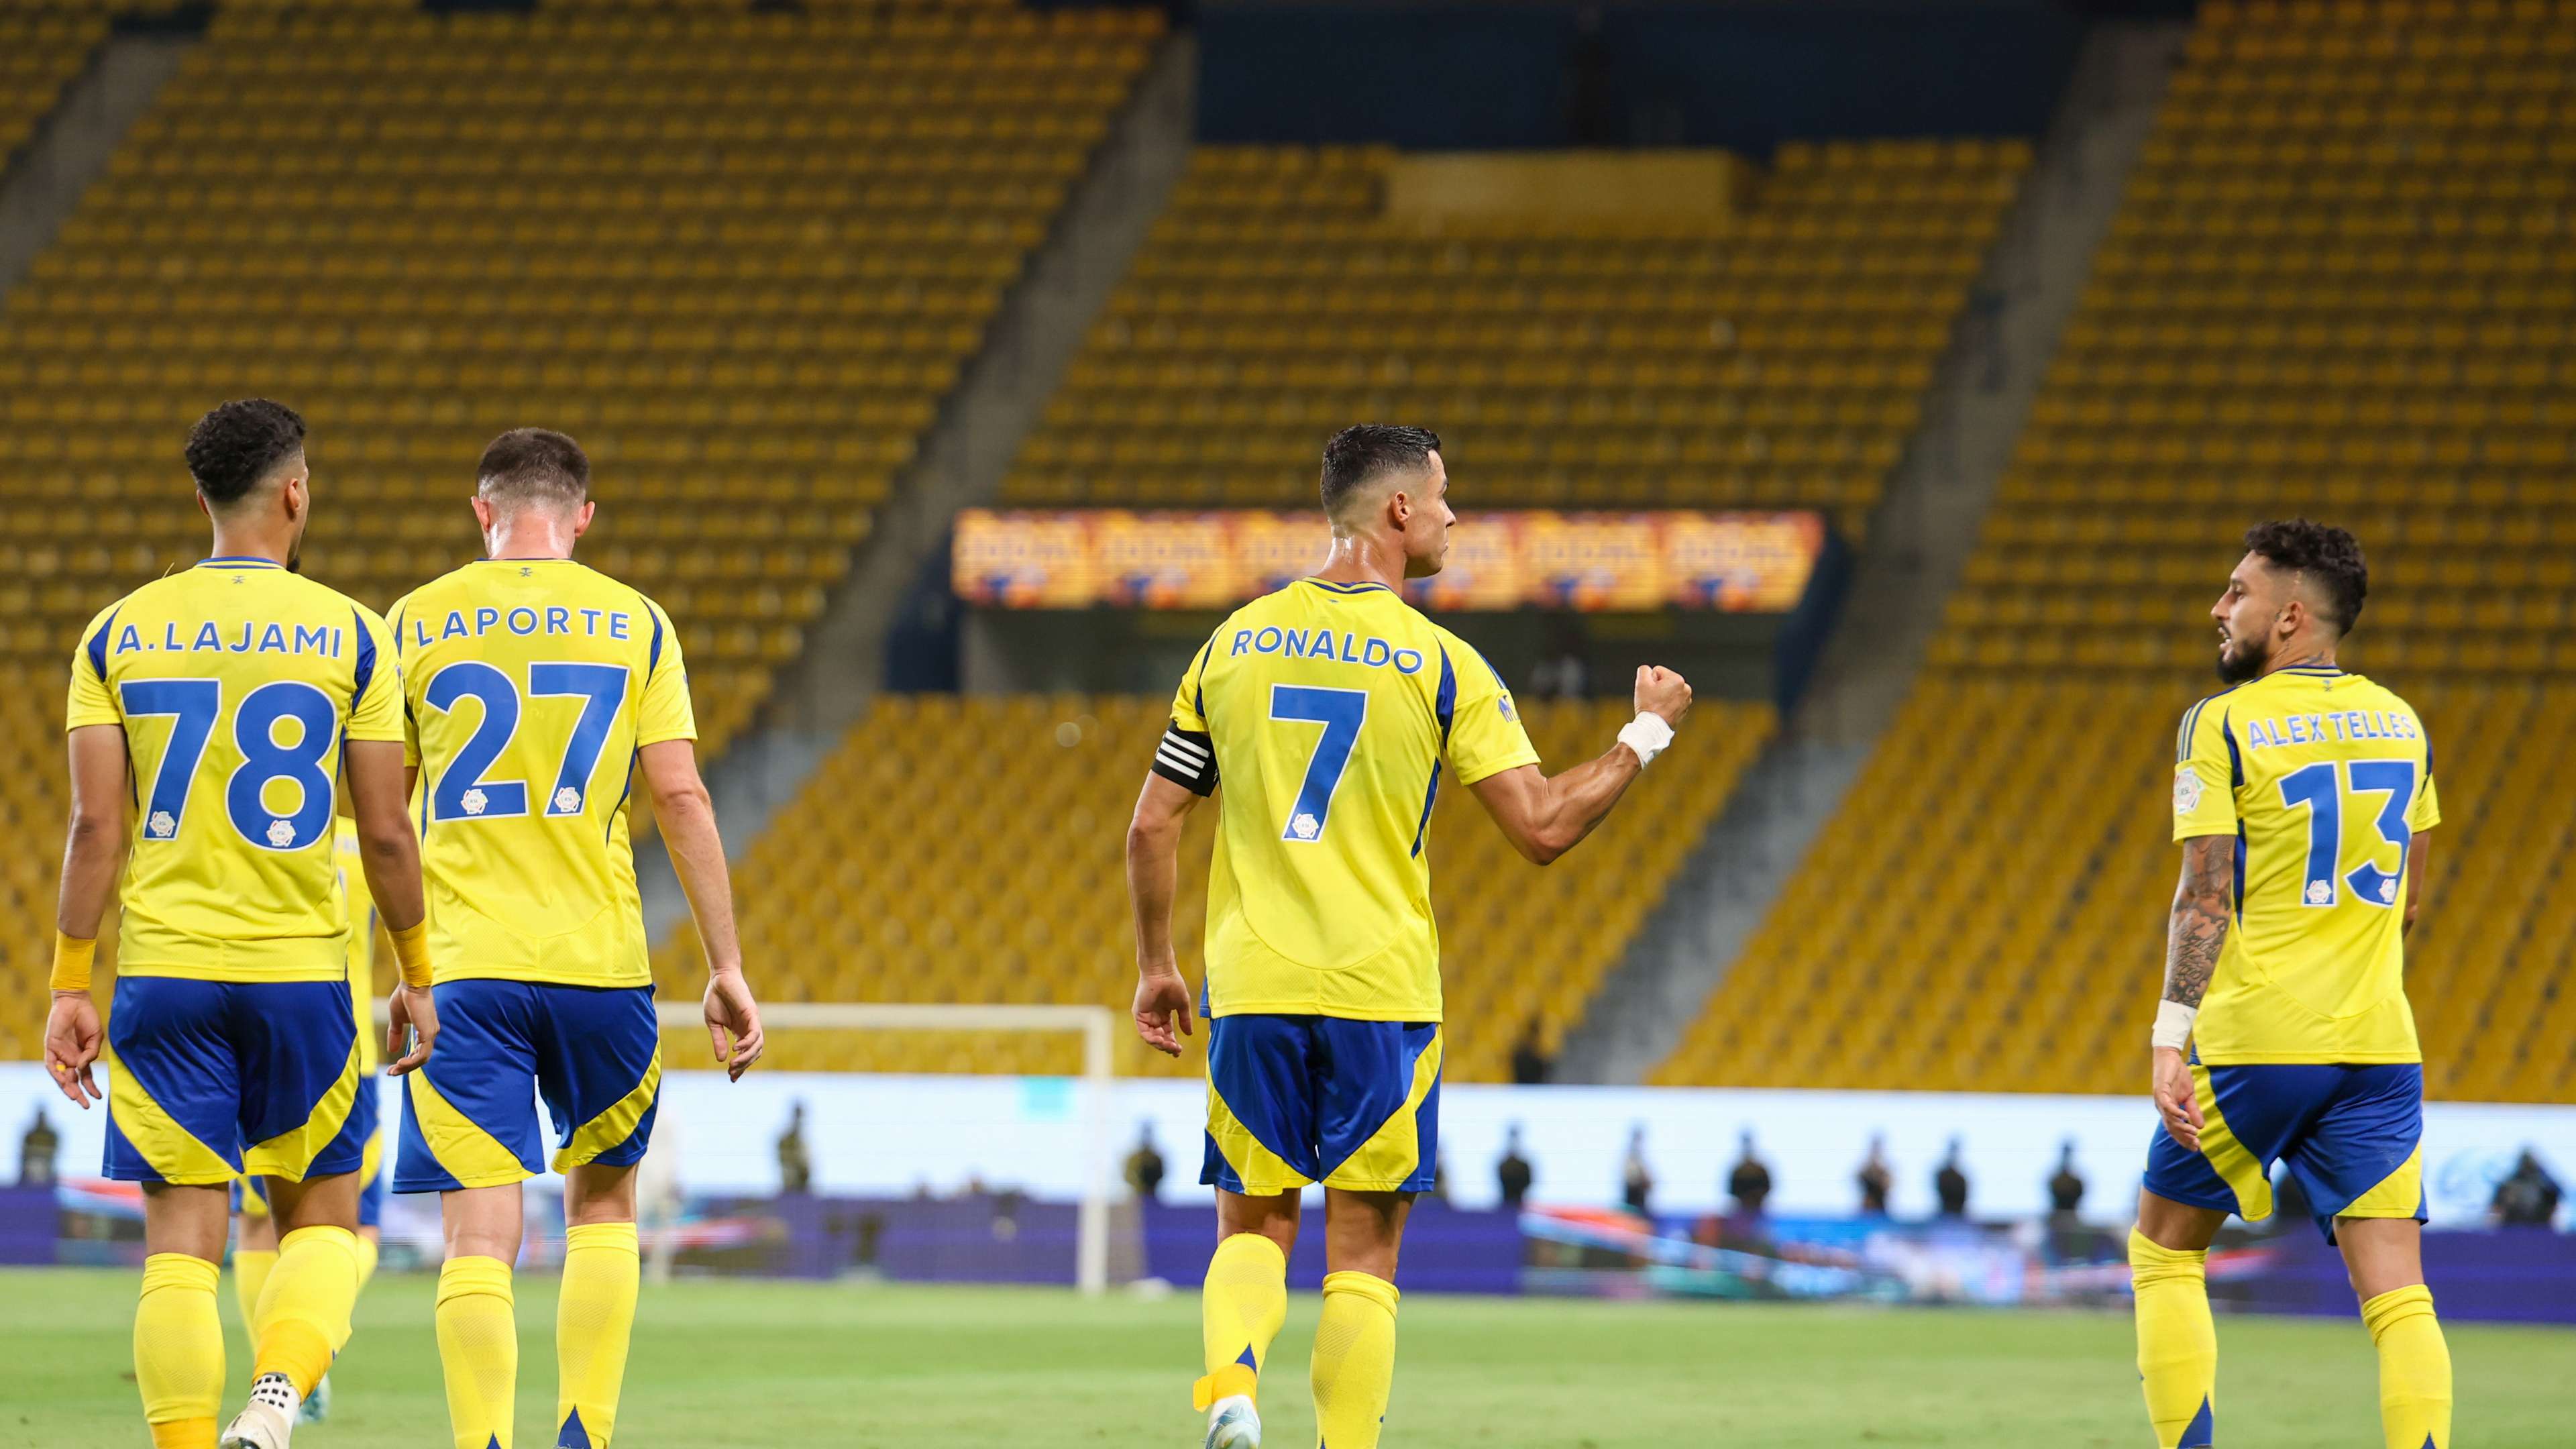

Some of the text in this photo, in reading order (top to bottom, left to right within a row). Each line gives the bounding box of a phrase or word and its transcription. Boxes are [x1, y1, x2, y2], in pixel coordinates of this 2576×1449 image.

[115, 621, 342, 658] A.LAJAMI
[415, 607, 629, 647] LAPORTE
[1232, 627, 1423, 674] RONALDO
[119, 679, 337, 850] 78
[425, 661, 631, 820] 27
[1269, 684, 1368, 841] 7
[2248, 711, 2416, 749] ALEX TELLES
[2279, 761, 2416, 906] 13
